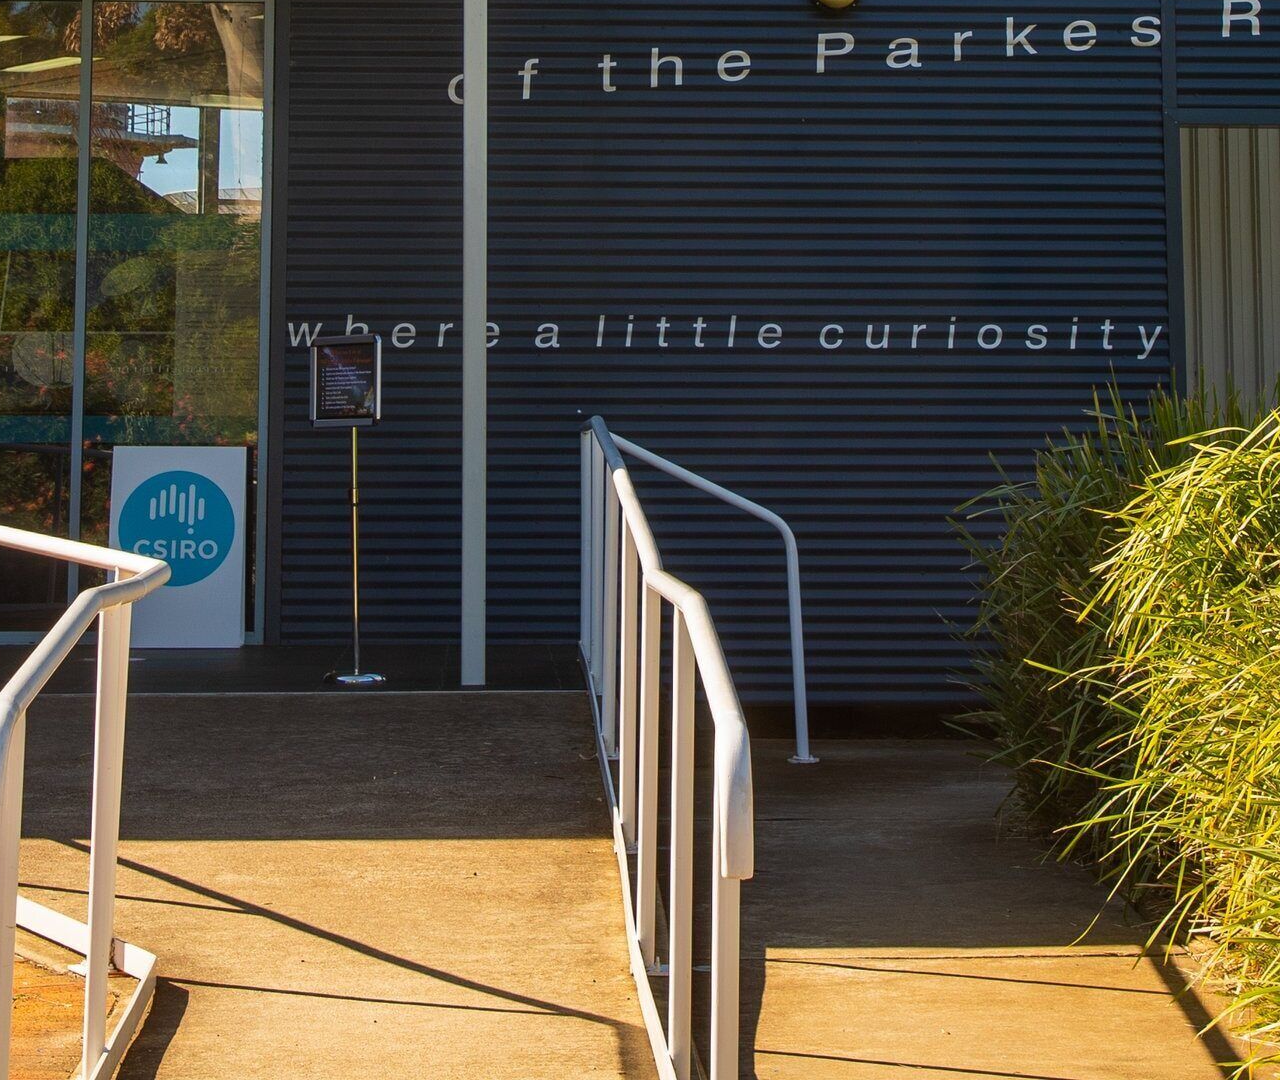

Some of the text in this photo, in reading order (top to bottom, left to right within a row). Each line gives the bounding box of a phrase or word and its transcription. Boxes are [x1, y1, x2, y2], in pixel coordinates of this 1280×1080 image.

[597, 46, 753, 93] the
[815, 14, 1162, 74] Parkes
[287, 313, 1165, 360] where a little curiosity
[132, 538, 219, 561] CSIRO
